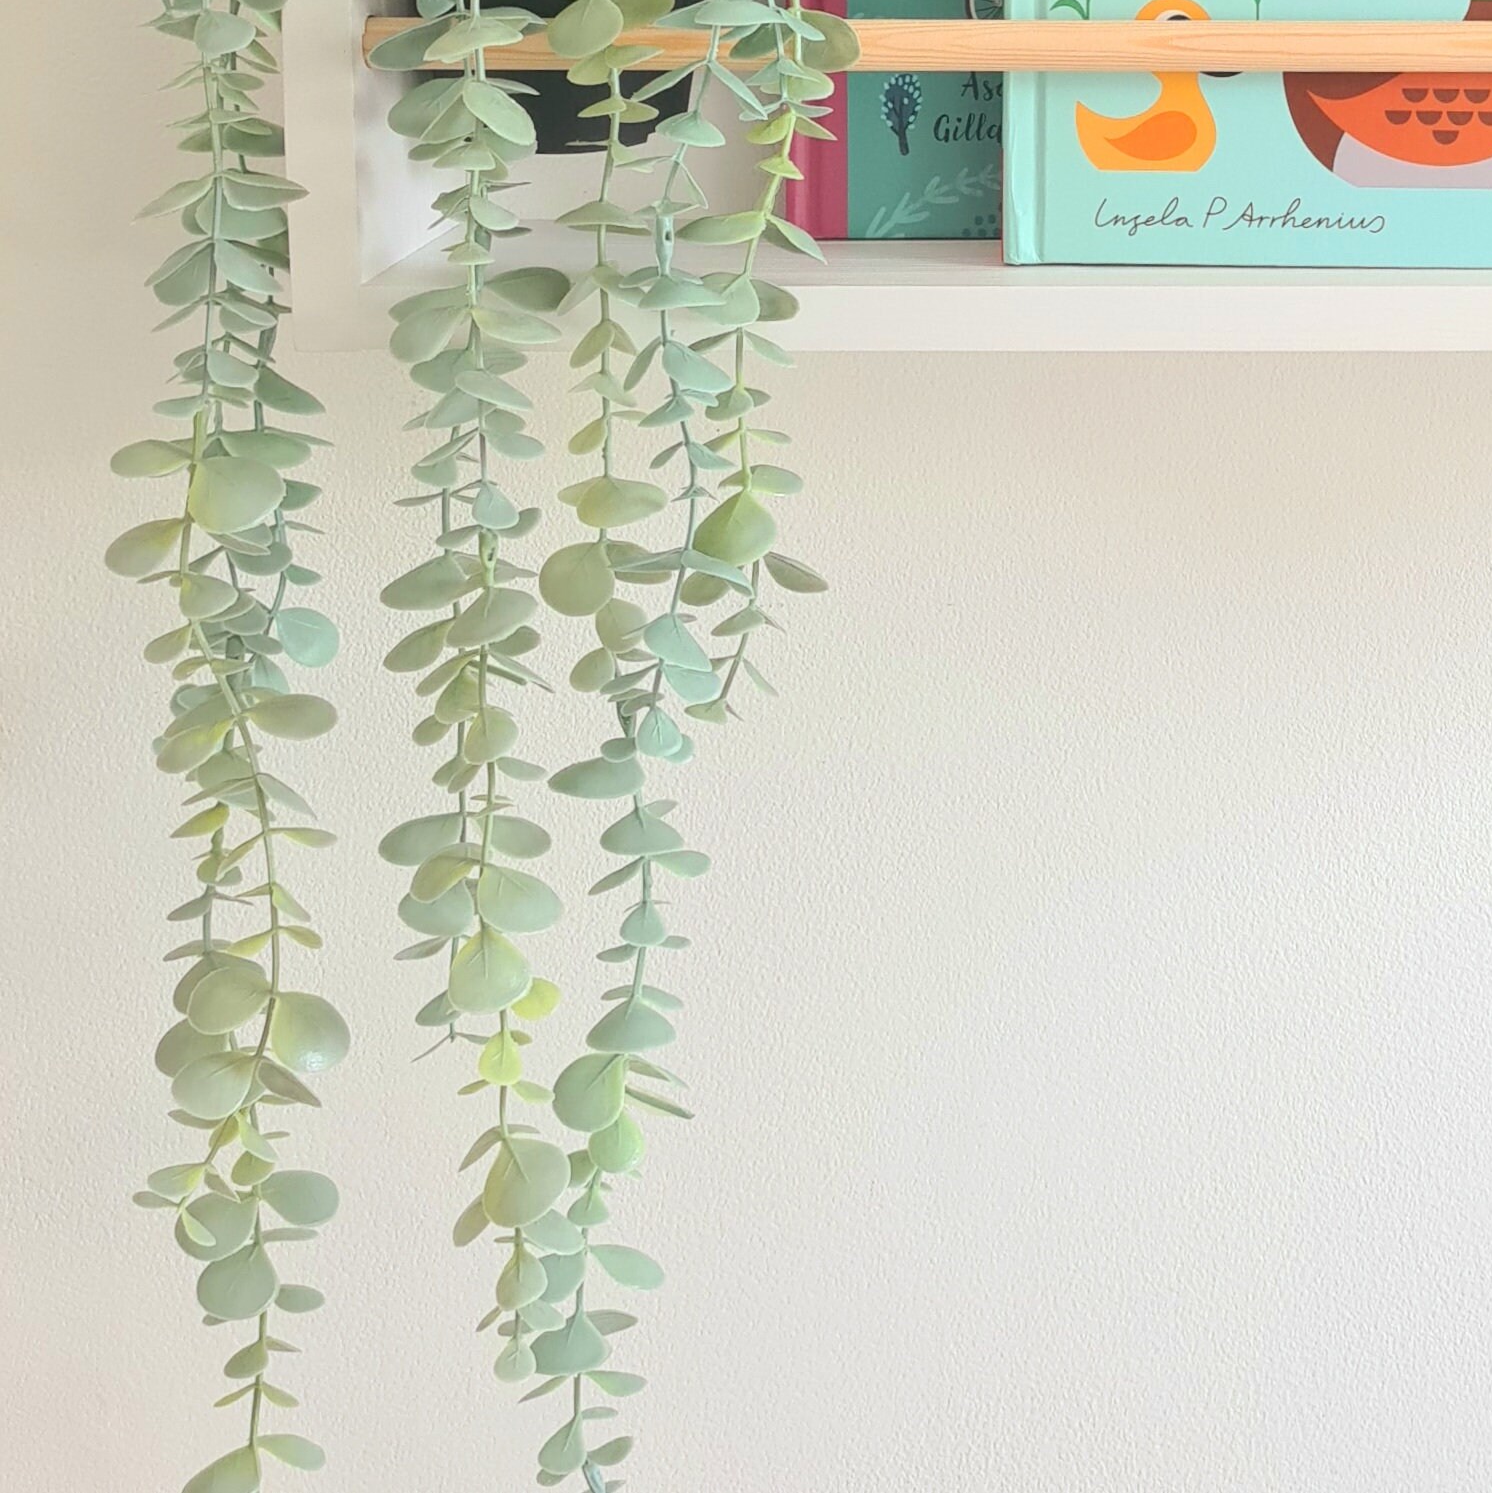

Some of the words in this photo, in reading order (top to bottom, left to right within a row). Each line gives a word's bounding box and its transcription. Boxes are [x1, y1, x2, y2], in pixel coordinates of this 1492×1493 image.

[1094, 196, 1194, 236] Ingela
[1202, 196, 1228, 229] P
[1222, 197, 1385, 234] Arrhenius
